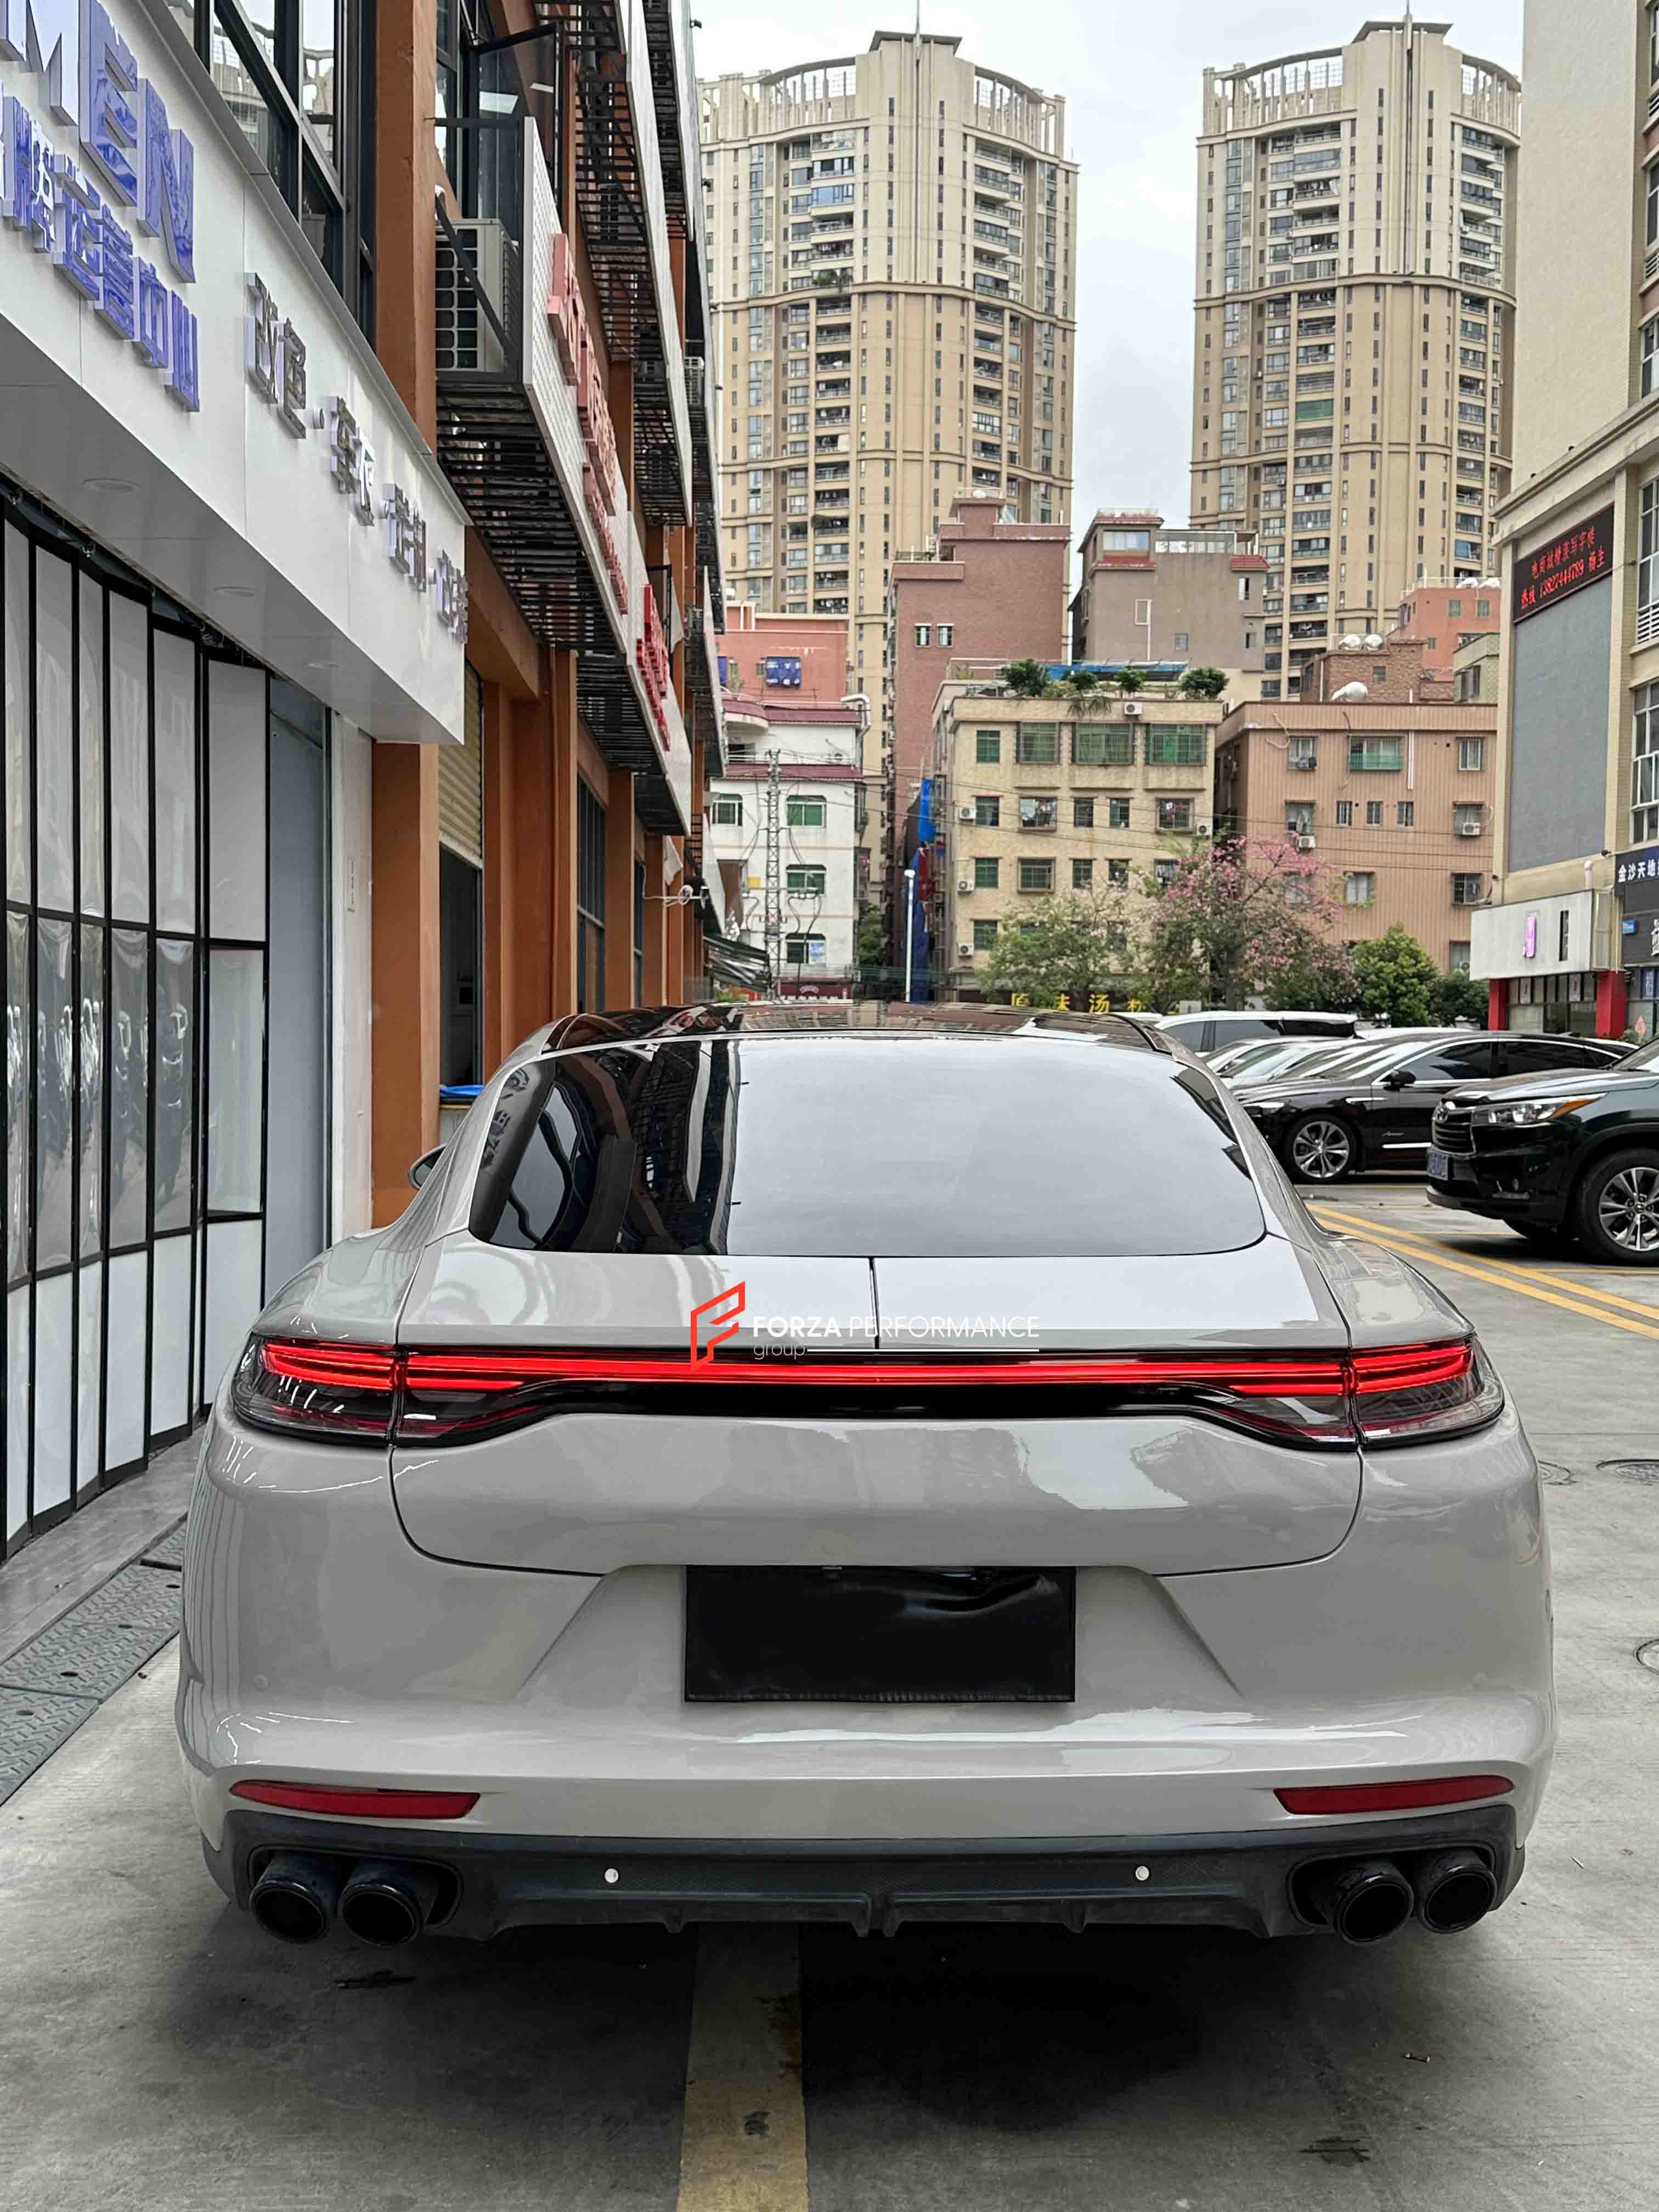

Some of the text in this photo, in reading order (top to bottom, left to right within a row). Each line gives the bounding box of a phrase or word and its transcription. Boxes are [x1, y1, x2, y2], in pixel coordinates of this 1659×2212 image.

[0, 85, 200, 412] 牌运营中心
[1618, 857, 1659, 883] 金沙天地
